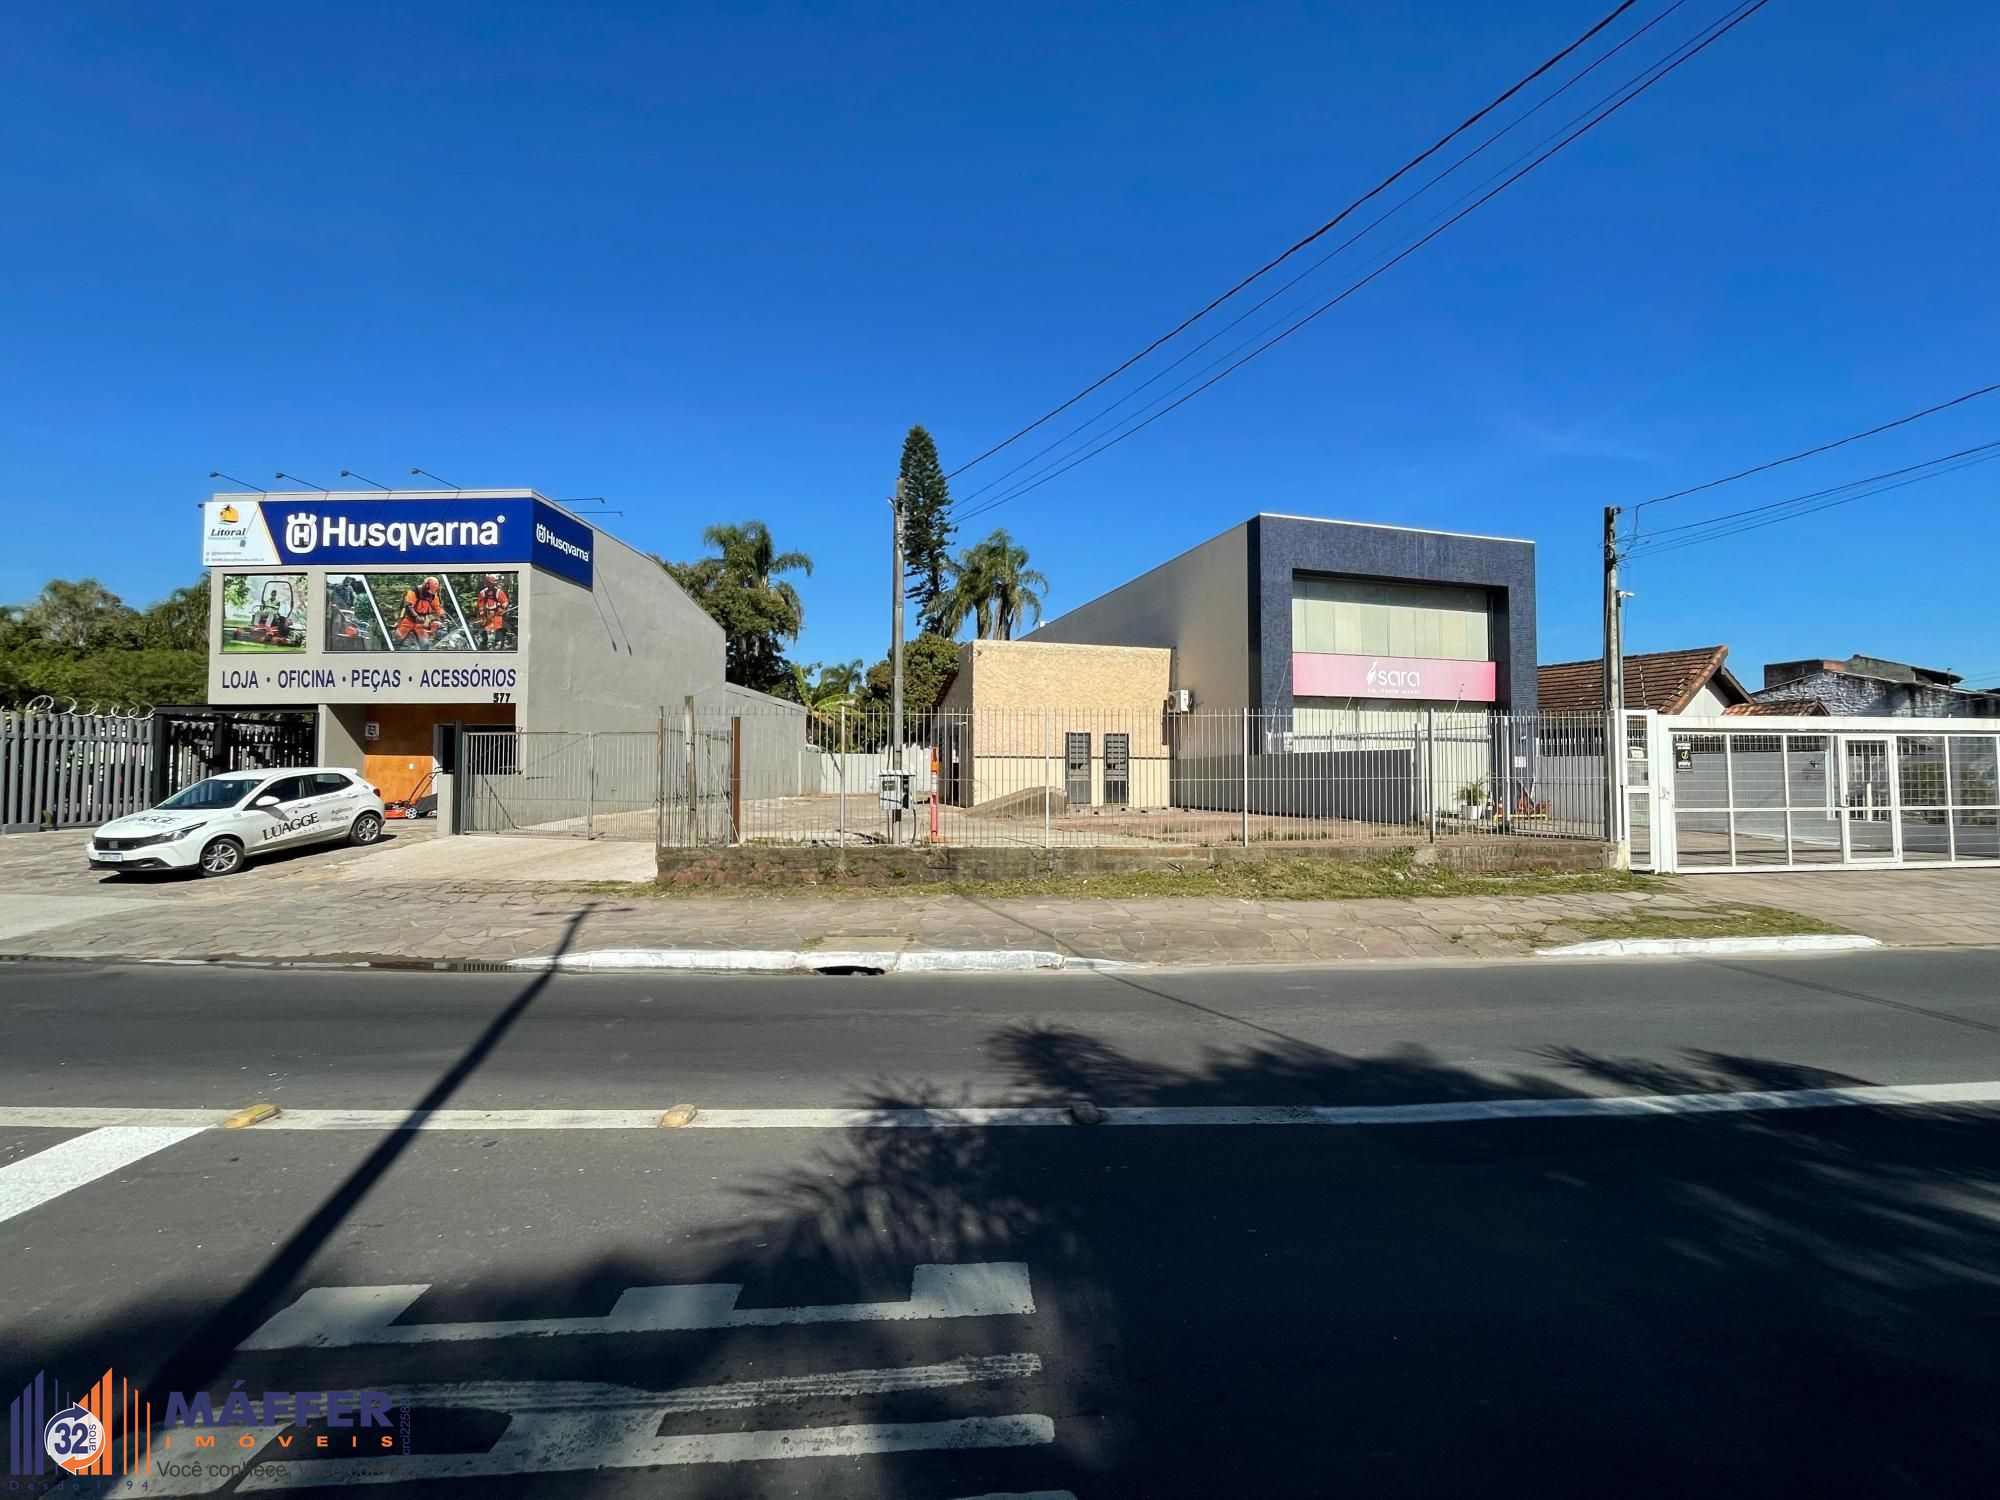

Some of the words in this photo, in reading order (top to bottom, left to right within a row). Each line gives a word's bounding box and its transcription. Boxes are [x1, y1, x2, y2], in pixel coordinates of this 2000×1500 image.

[210, 527, 247, 537] Litoral
[322, 516, 498, 552] Husqvarna
[546, 529, 590, 562] Husqvarna
[221, 670, 259, 689] LOJA
[277, 669, 336, 689] OFICINA
[350, 669, 401, 693] PEÇAS
[419, 663, 517, 688] ACESSÓRIOS
[1377, 670, 1421, 687] sara
[261, 811, 320, 841] LUAGGE
